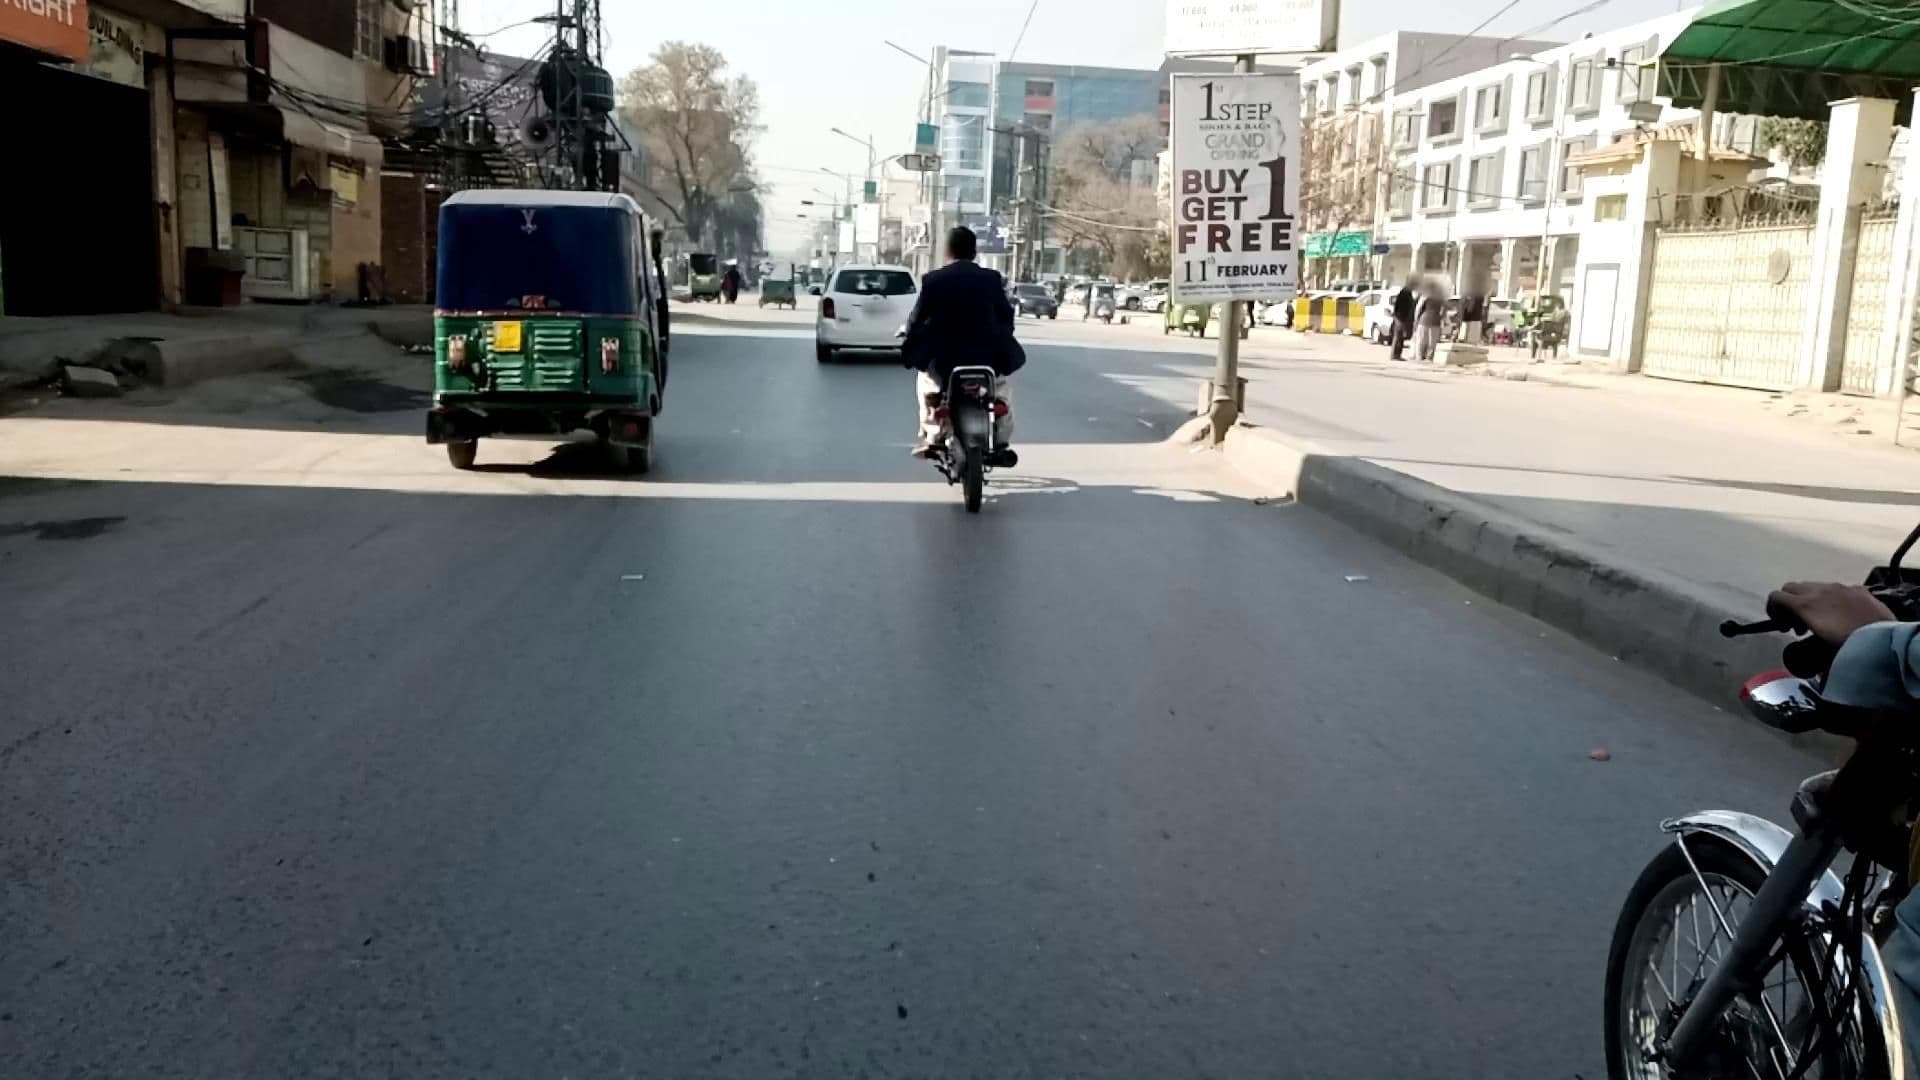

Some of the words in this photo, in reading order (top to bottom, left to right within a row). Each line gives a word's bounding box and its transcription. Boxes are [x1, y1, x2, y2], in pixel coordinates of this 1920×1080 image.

[3, 0, 76, 26] GHT
[1219, 102, 1273, 121] STEP
[1205, 132, 1265, 149] GRAND
[1182, 168, 1249, 195] BUY
[1258, 156, 1294, 221] 1
[1182, 196, 1248, 222] GET
[1178, 222, 1292, 254] FREE
[1217, 263, 1288, 278] FEBRUARY
